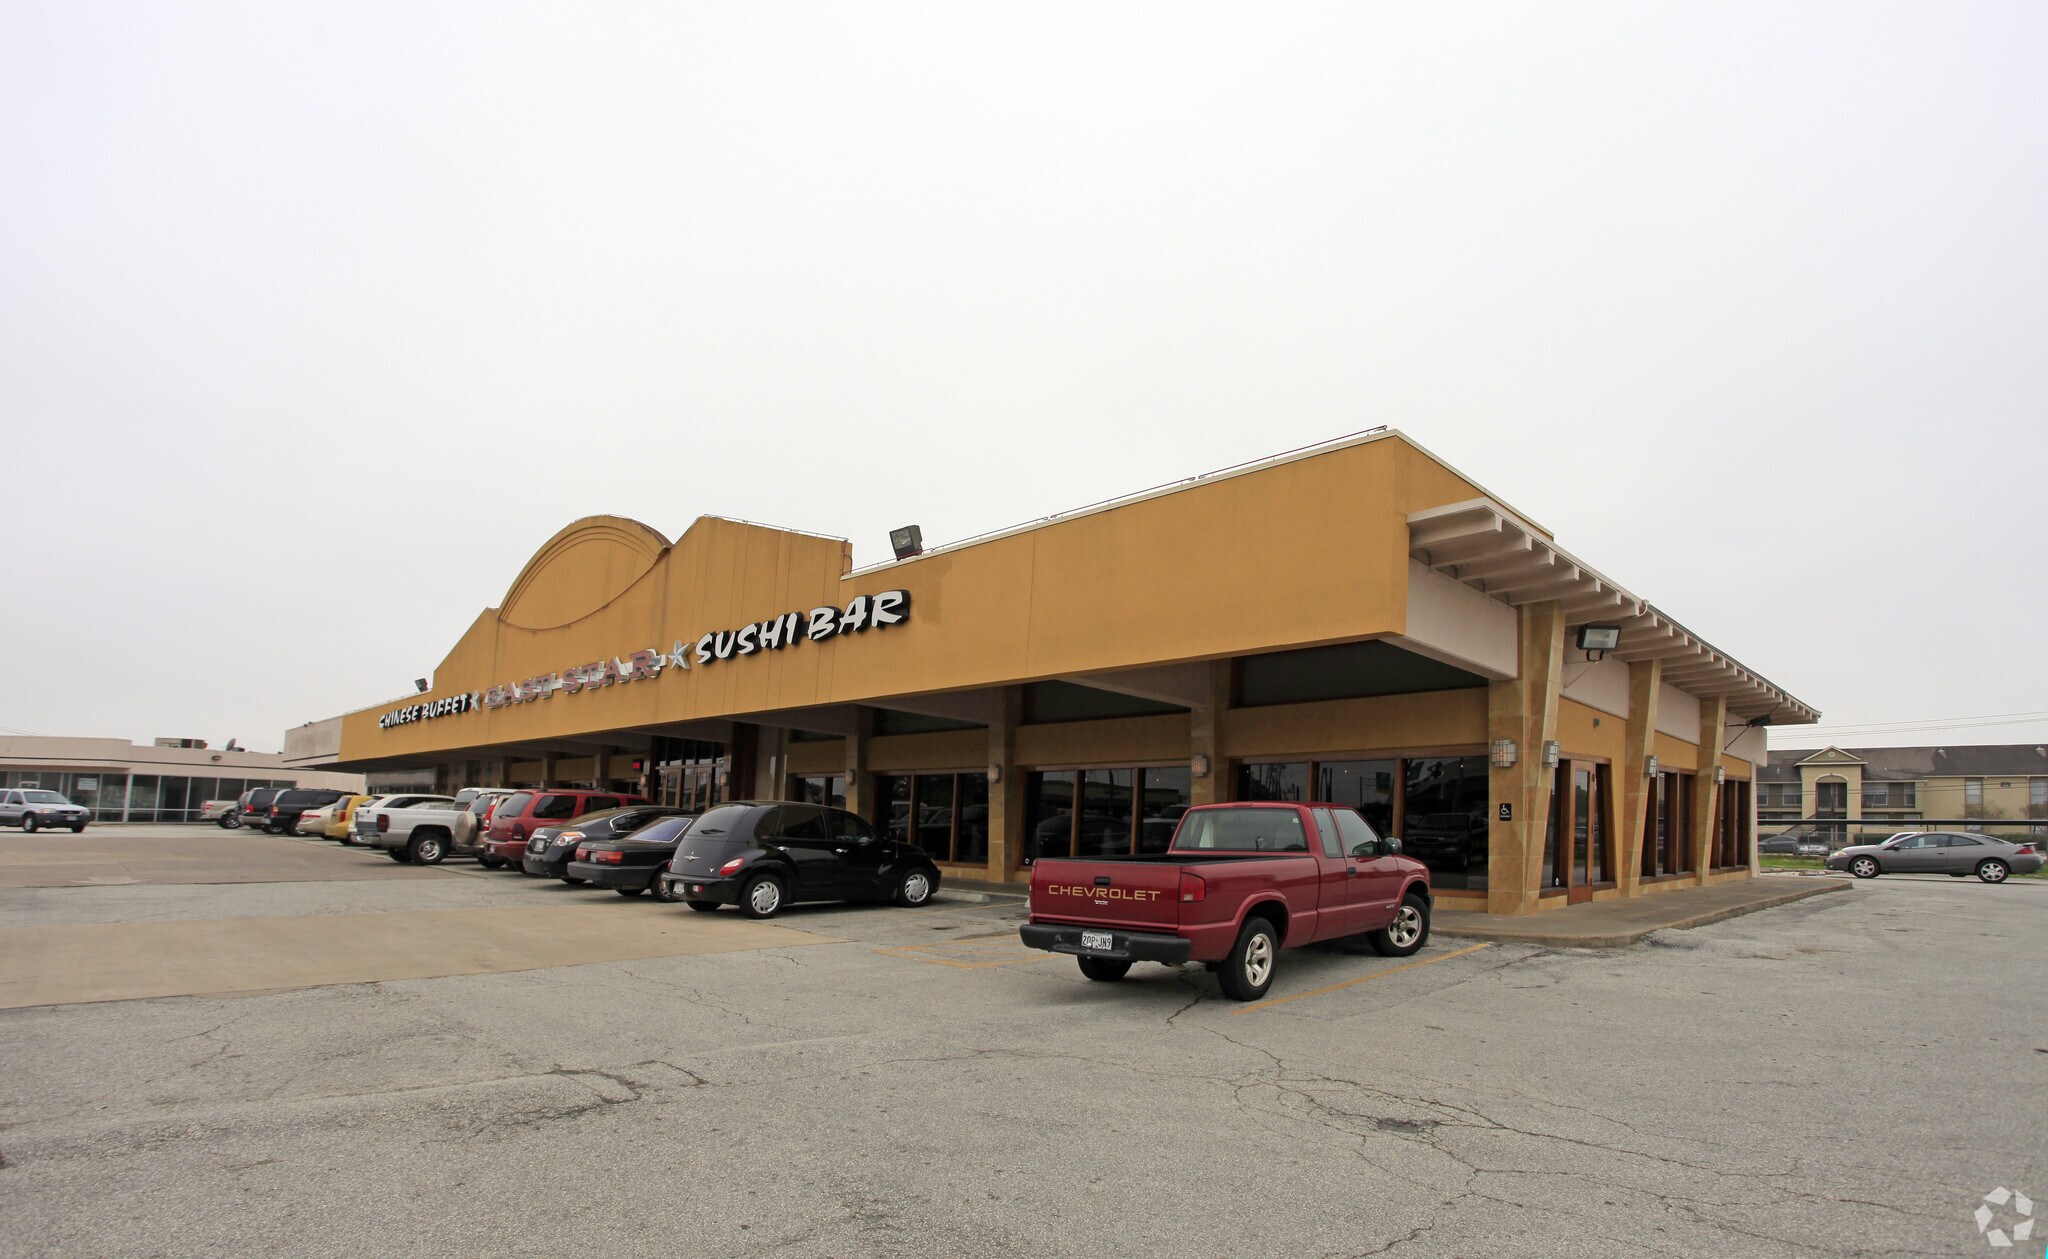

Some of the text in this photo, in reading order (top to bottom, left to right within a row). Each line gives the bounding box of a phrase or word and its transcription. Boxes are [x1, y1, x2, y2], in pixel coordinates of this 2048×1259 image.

[379, 590, 911, 729] CHINESE BUFFET EAST STAR SUSHI BAR
[1048, 884, 1161, 901] CHEVROLET
